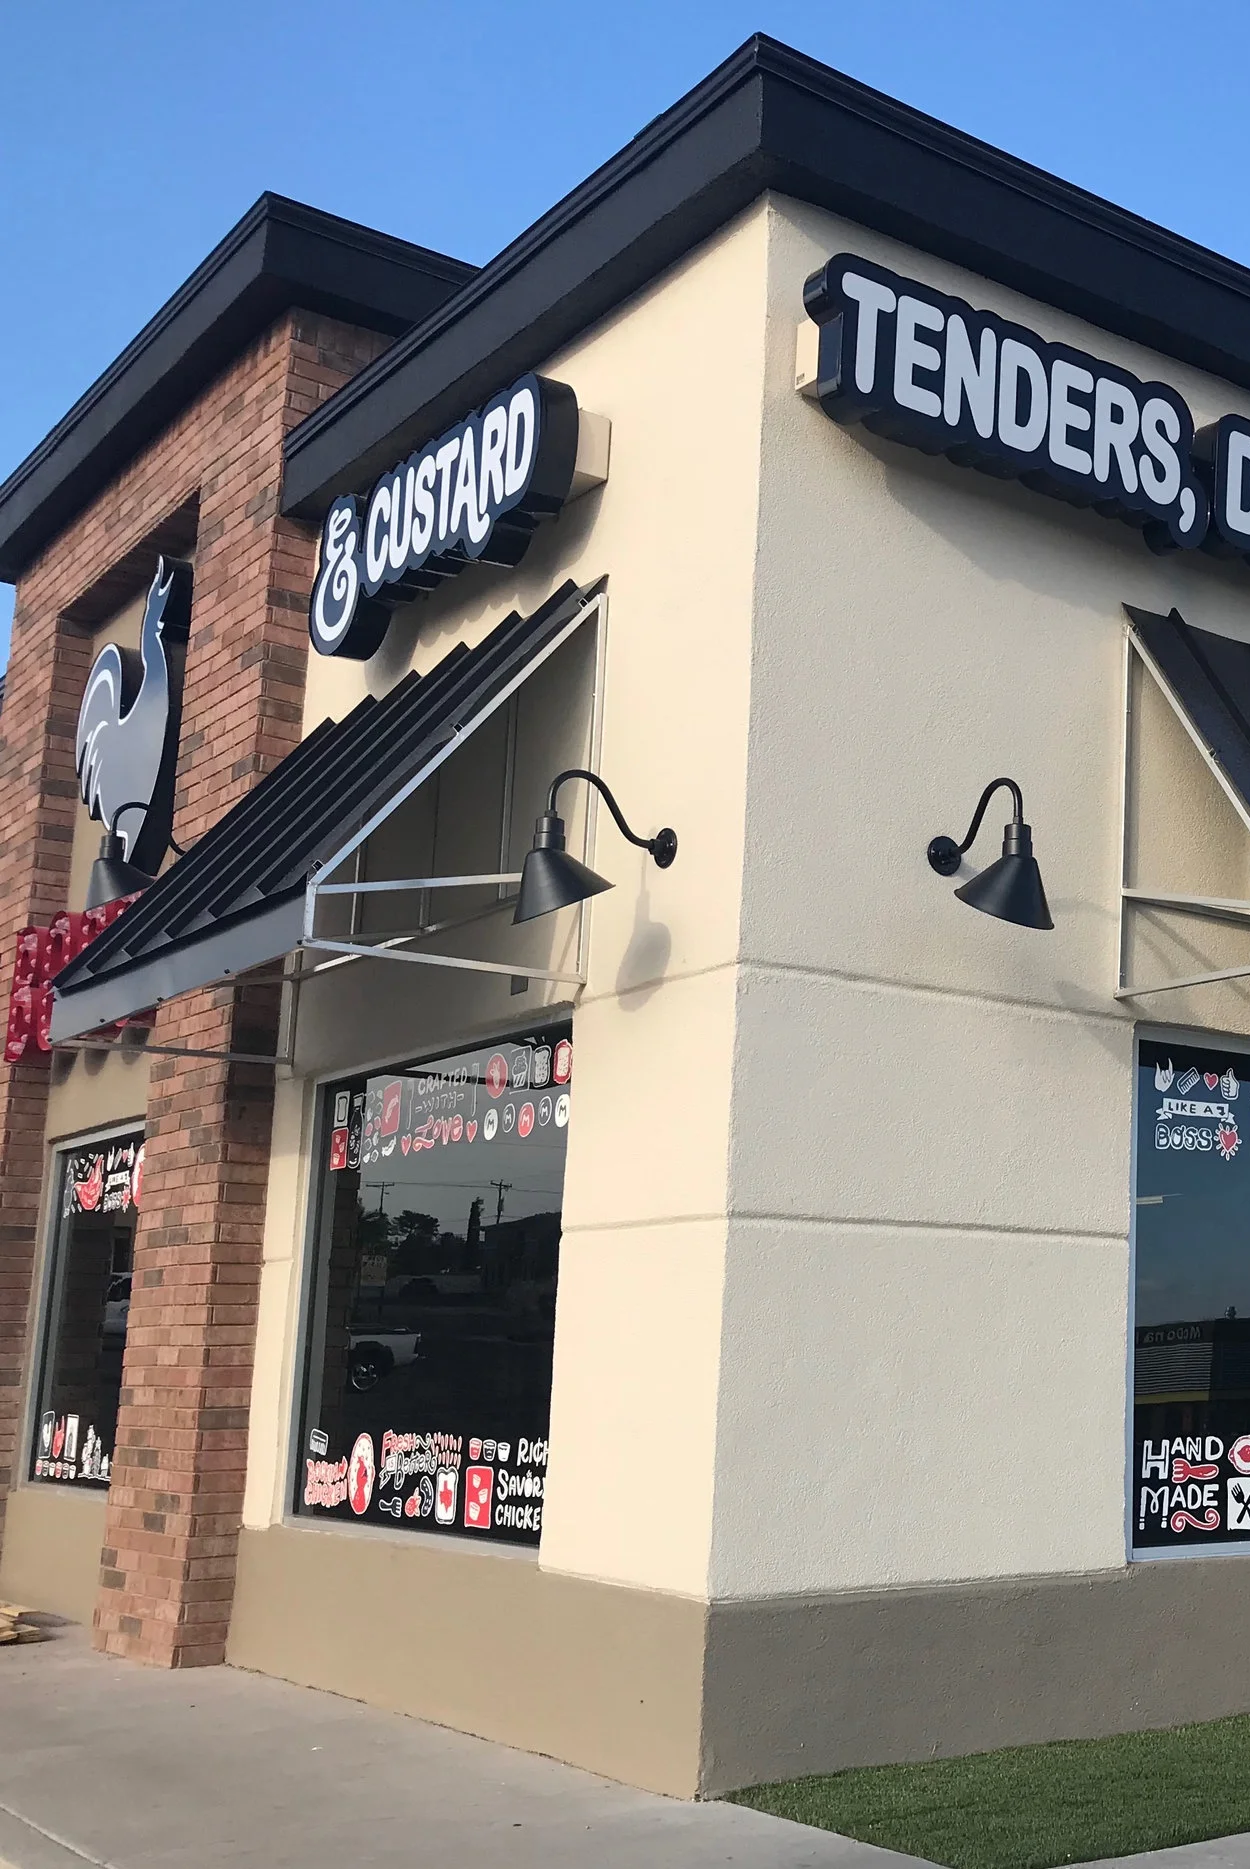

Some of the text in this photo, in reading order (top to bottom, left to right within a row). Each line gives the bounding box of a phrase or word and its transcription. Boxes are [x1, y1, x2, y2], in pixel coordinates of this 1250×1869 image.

[842, 271, 1196, 533] TENDERS,
[315, 388, 535, 641] & CUSTARD
[418, 1066, 468, 1095] CRAFTED
[1168, 1101, 1213, 1114] LIKE A
[1155, 1123, 1212, 1151] BOSS
[1142, 1436, 1224, 1479] HAND
[497, 1469, 545, 1501] SAVOR
[1139, 1484, 1219, 1530] MADE
